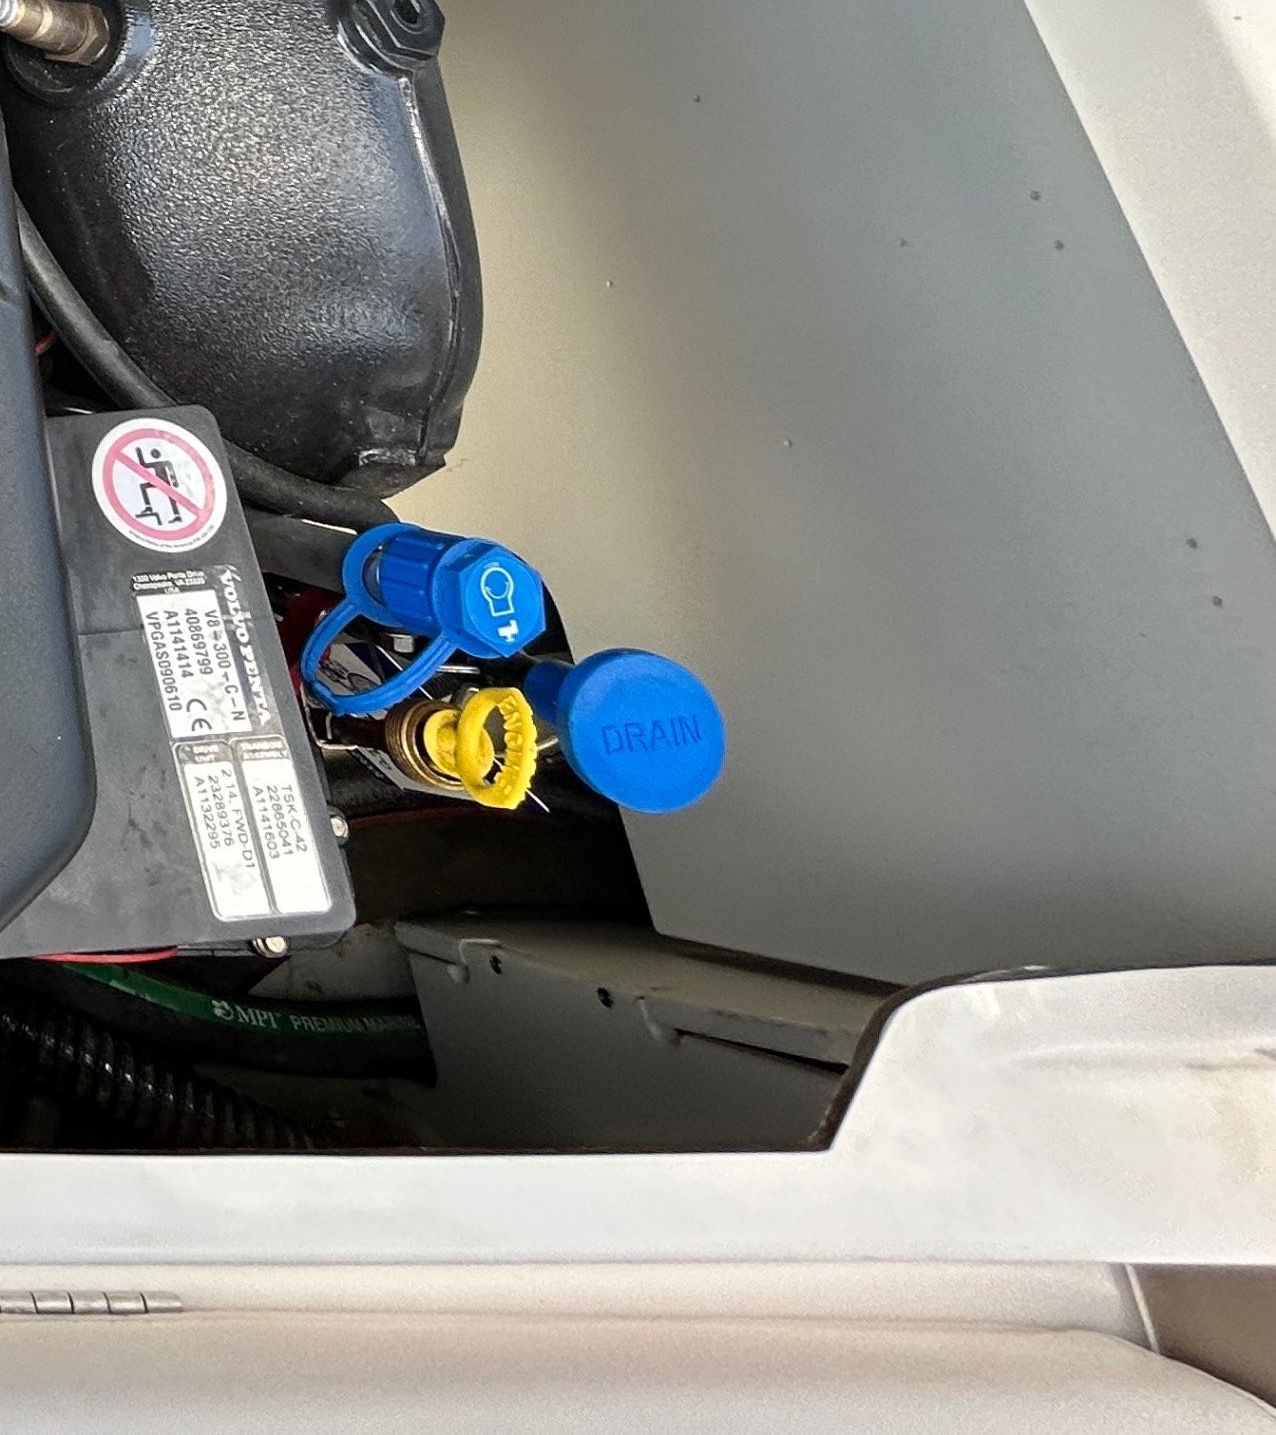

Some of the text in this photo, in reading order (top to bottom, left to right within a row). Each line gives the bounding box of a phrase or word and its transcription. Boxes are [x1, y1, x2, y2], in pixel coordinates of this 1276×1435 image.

[145, 611, 183, 712] VPGAS090610
[163, 609, 195, 679] A1141414
[185, 608, 214, 676] 40869799
[219, 570, 272, 725] VOLVO PENTA
[601, 714, 704, 756] DRAIN
[193, 776, 222, 849] A1132295
[207, 775, 235, 847] 23289376
[231, 808, 256, 868] FWD-D1
[252, 786, 280, 859] A1141603
[266, 785, 294, 856] 22865041
[281, 784, 308, 852] TSK-C-42
